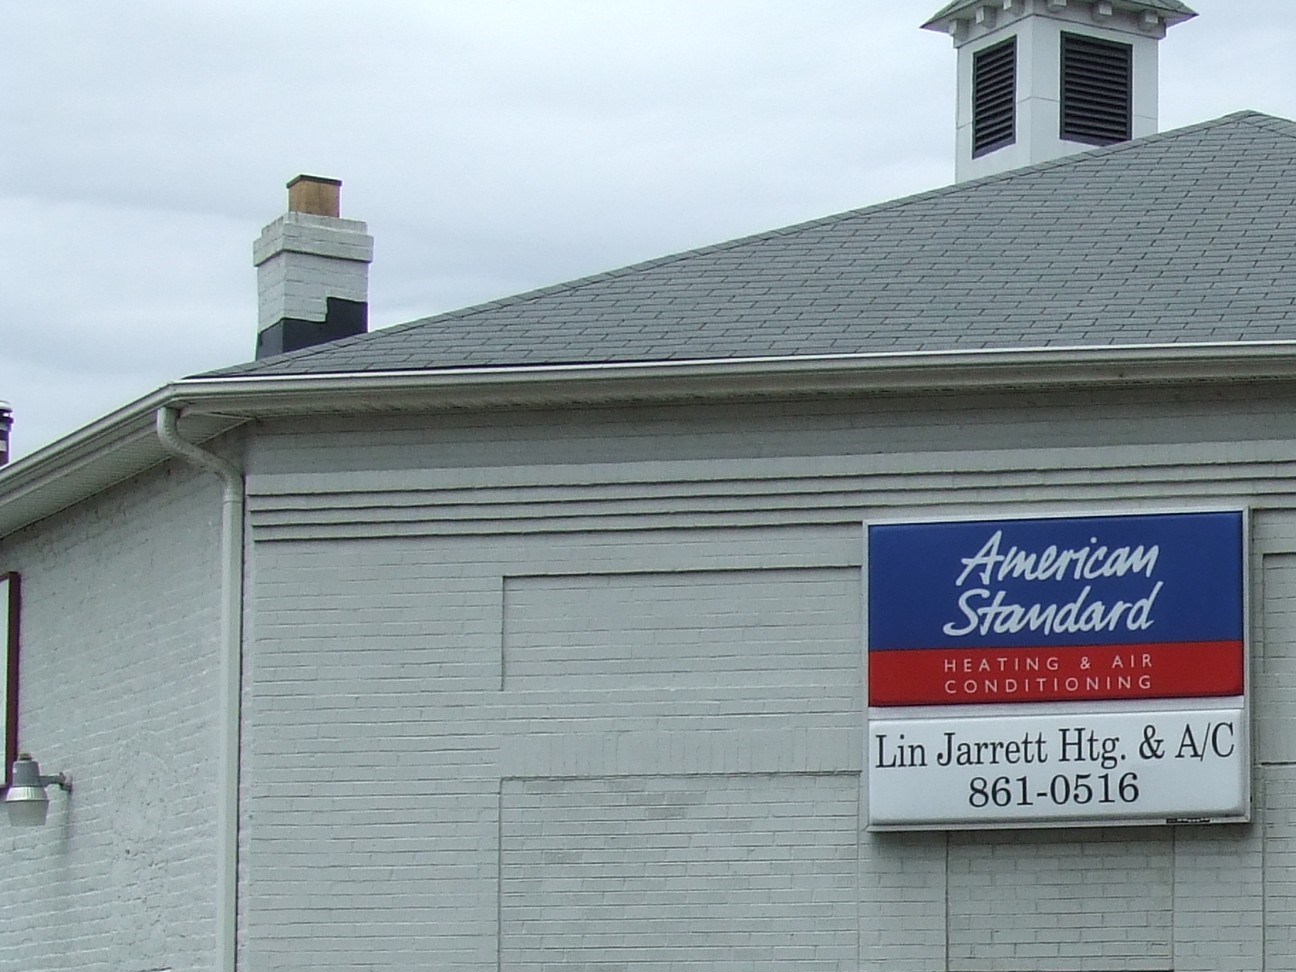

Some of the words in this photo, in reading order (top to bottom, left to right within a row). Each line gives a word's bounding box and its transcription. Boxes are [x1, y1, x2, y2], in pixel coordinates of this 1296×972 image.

[955, 530, 1160, 586] American
[943, 581, 1164, 636] Standard
[944, 656, 1060, 673] HEATING
[1079, 656, 1092, 670] &
[1112, 653, 1153, 669] AIR
[944, 675, 1152, 694] CONDITIONING
[875, 733, 927, 769] Lin
[936, 730, 1048, 767] Jarrett
[1059, 727, 1127, 770] Htg.
[1138, 724, 1165, 760] &
[1175, 721, 1235, 762] A/C
[968, 772, 1140, 808] 861-0516
